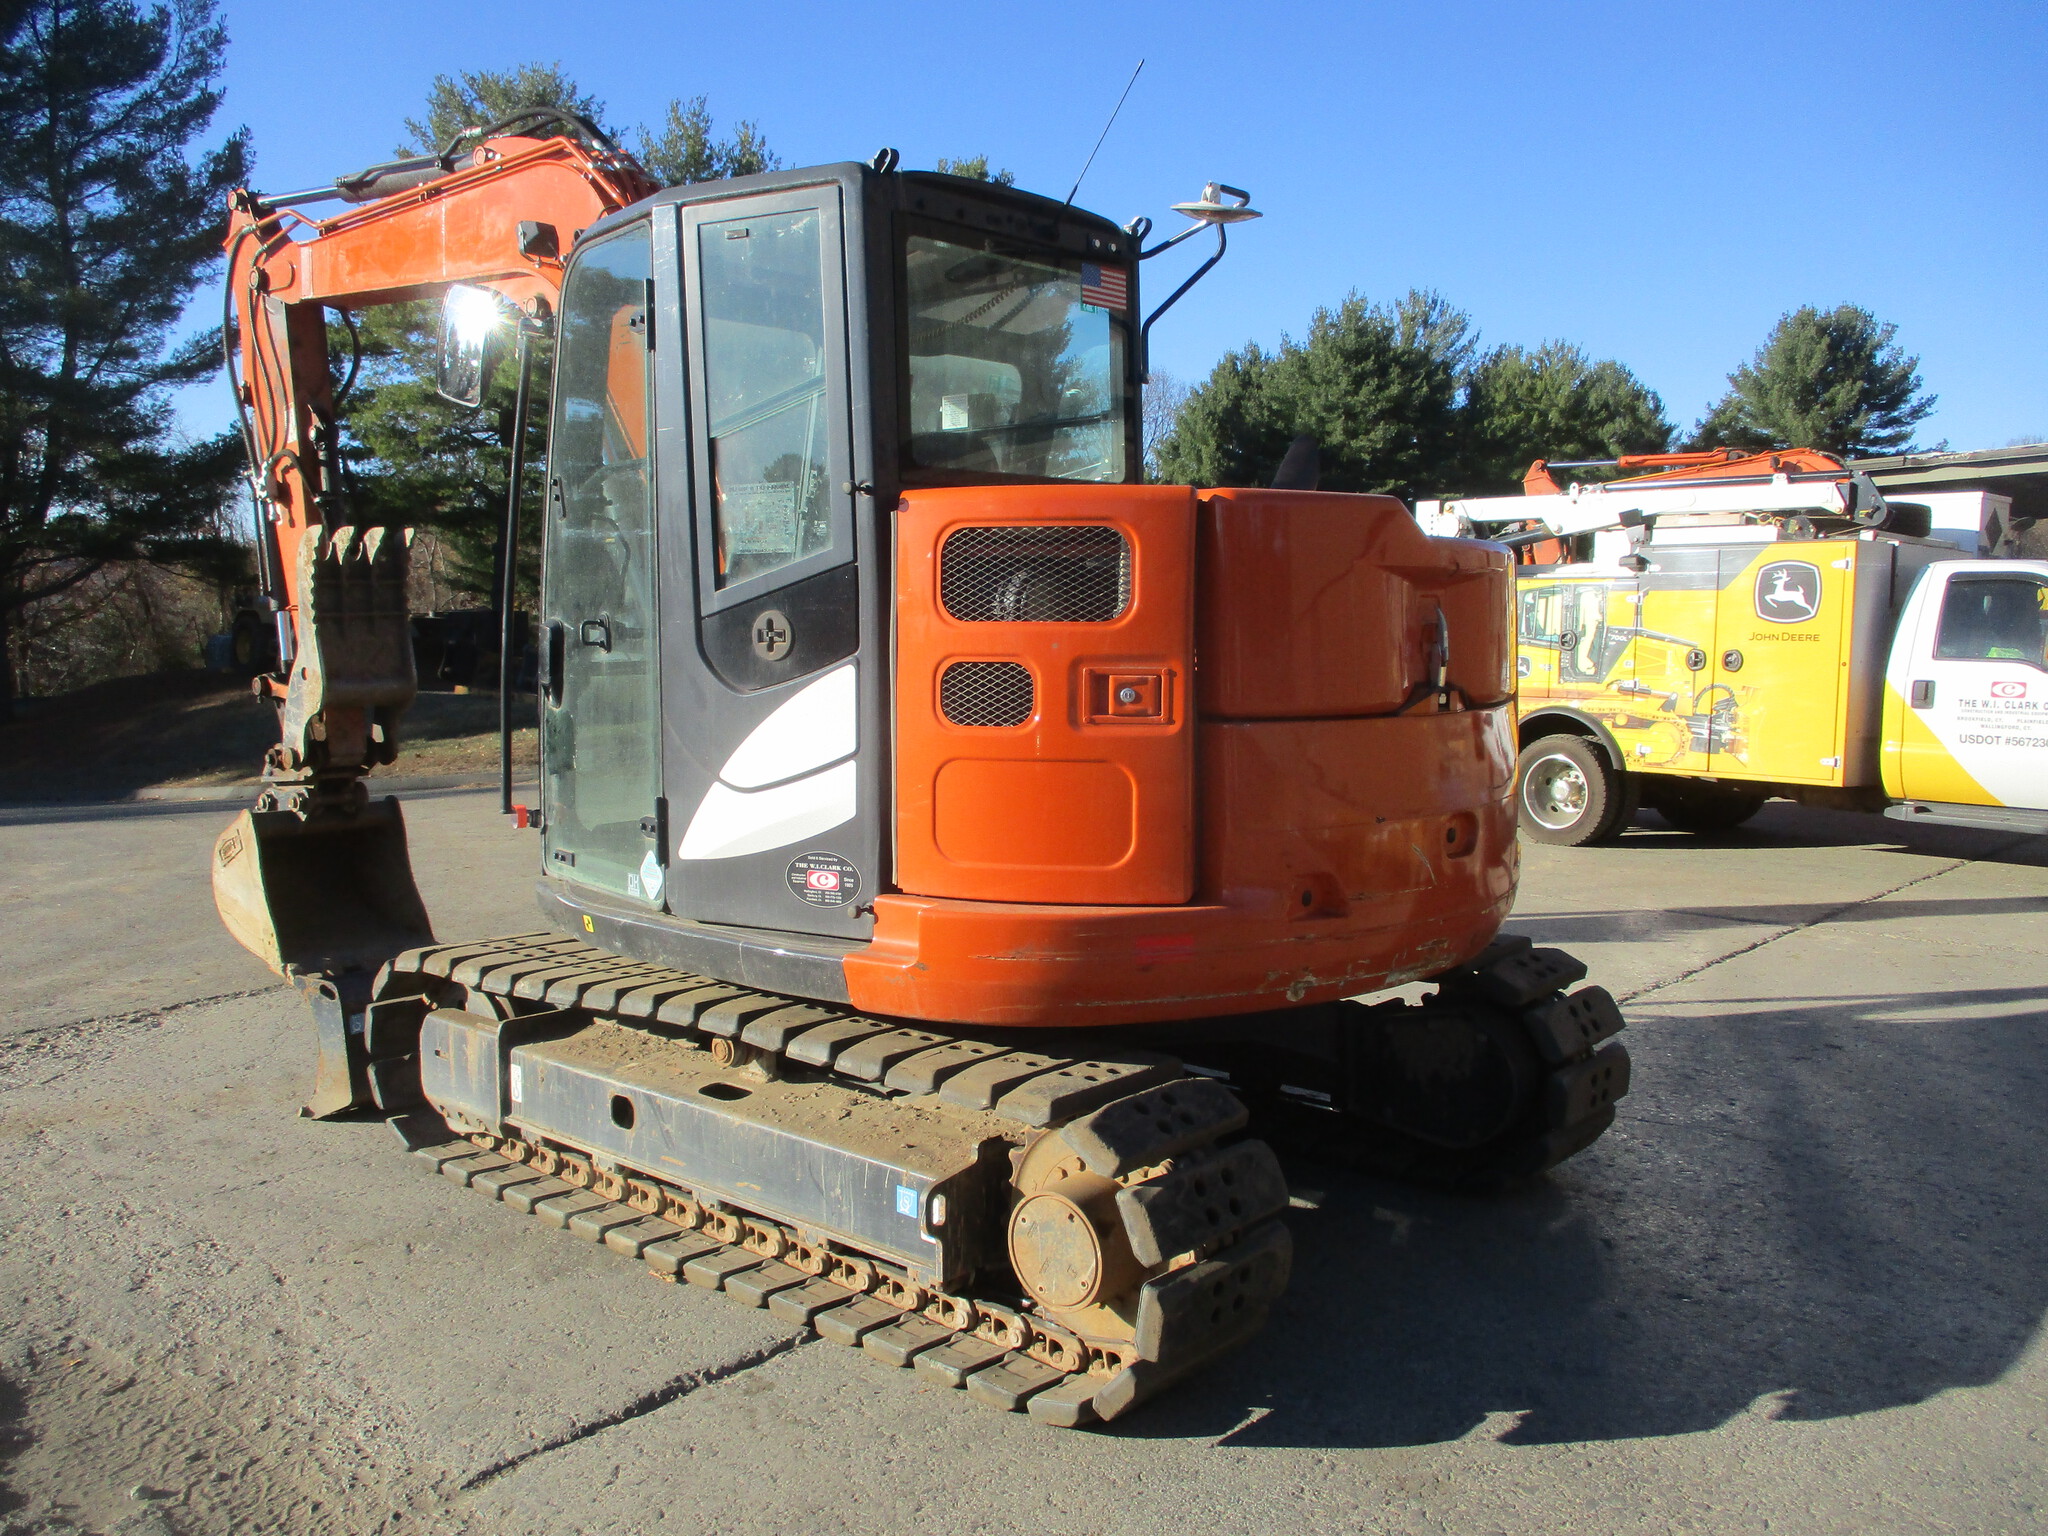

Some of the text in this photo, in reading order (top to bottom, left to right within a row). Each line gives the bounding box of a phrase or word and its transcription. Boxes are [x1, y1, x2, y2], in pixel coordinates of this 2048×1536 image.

[1749, 632, 1820, 642] JOHN DEERE
[1958, 699, 1977, 708] THE
[1981, 699, 2000, 709] W.I.
[2004, 700, 2039, 710] CLARK
[1959, 734, 2001, 745] USDOT
